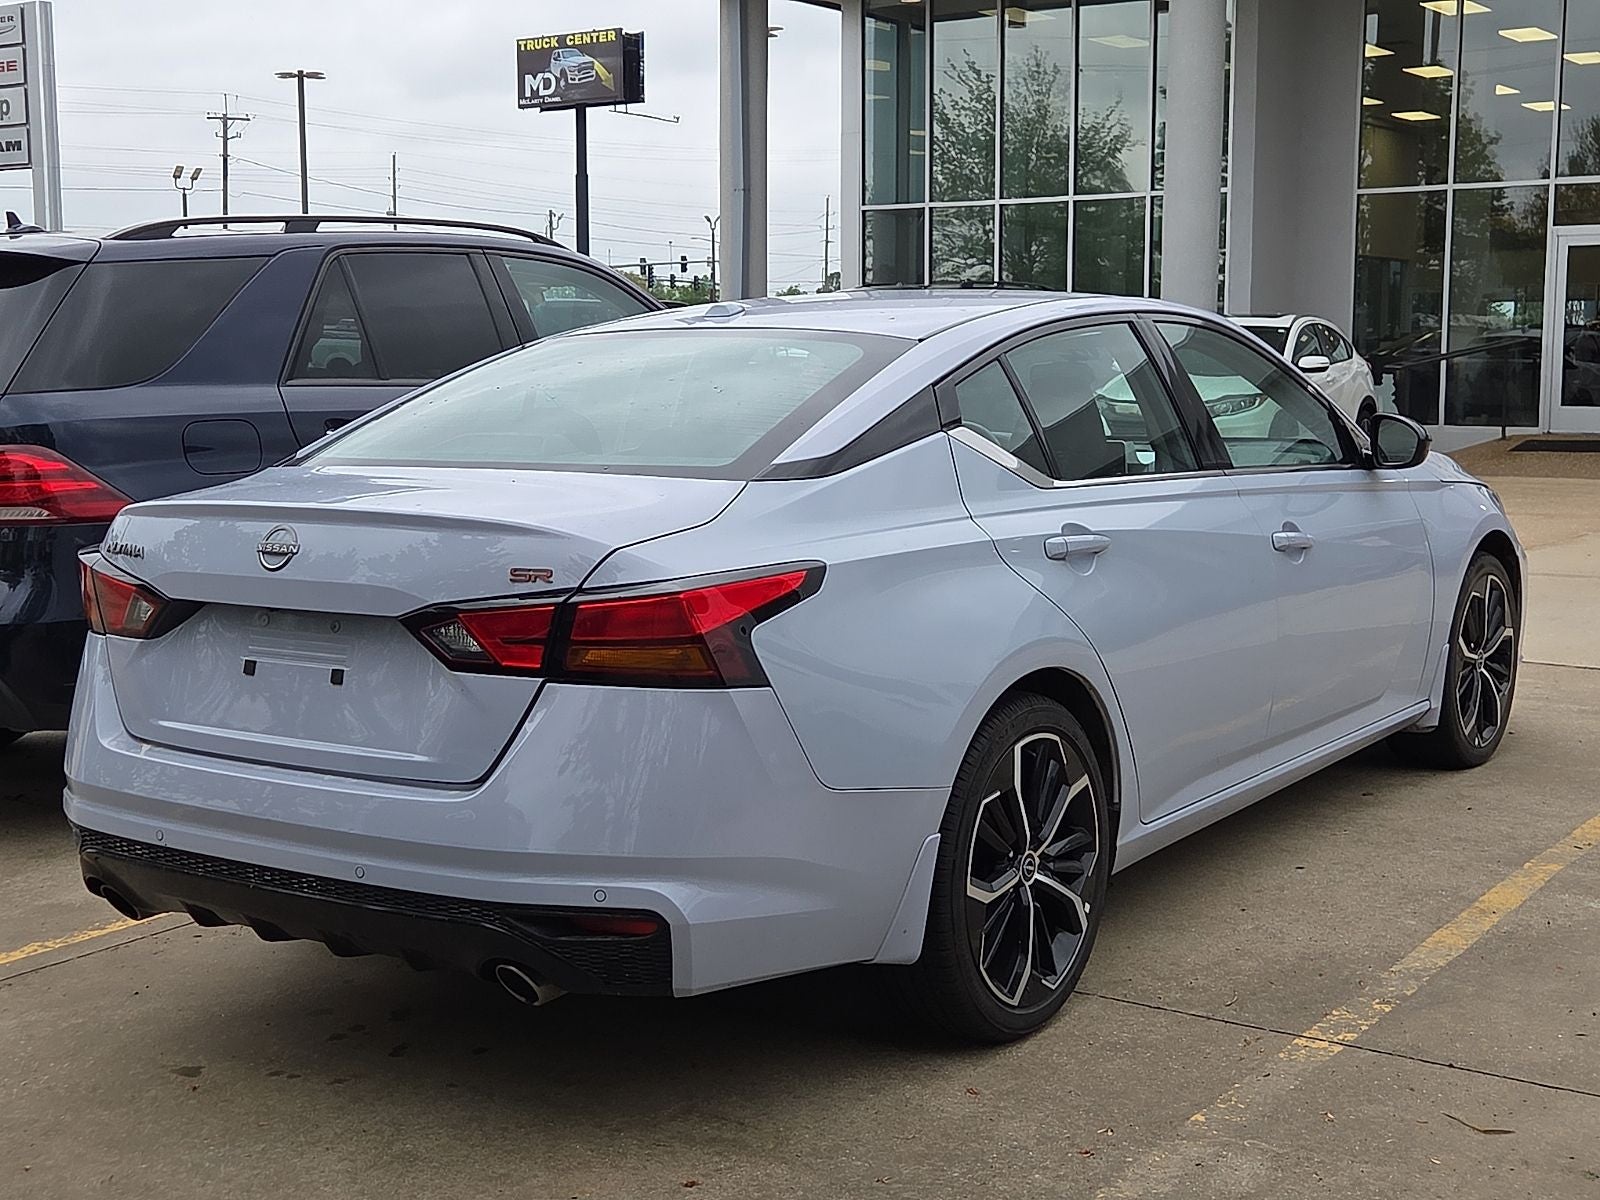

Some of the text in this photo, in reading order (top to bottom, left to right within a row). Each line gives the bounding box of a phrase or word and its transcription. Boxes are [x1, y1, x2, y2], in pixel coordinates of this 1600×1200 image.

[519, 30, 616, 51] TRUCK CENTER
[525, 72, 556, 97] MD
[258, 543, 299, 553] NISSAN
[510, 567, 554, 583] SR
